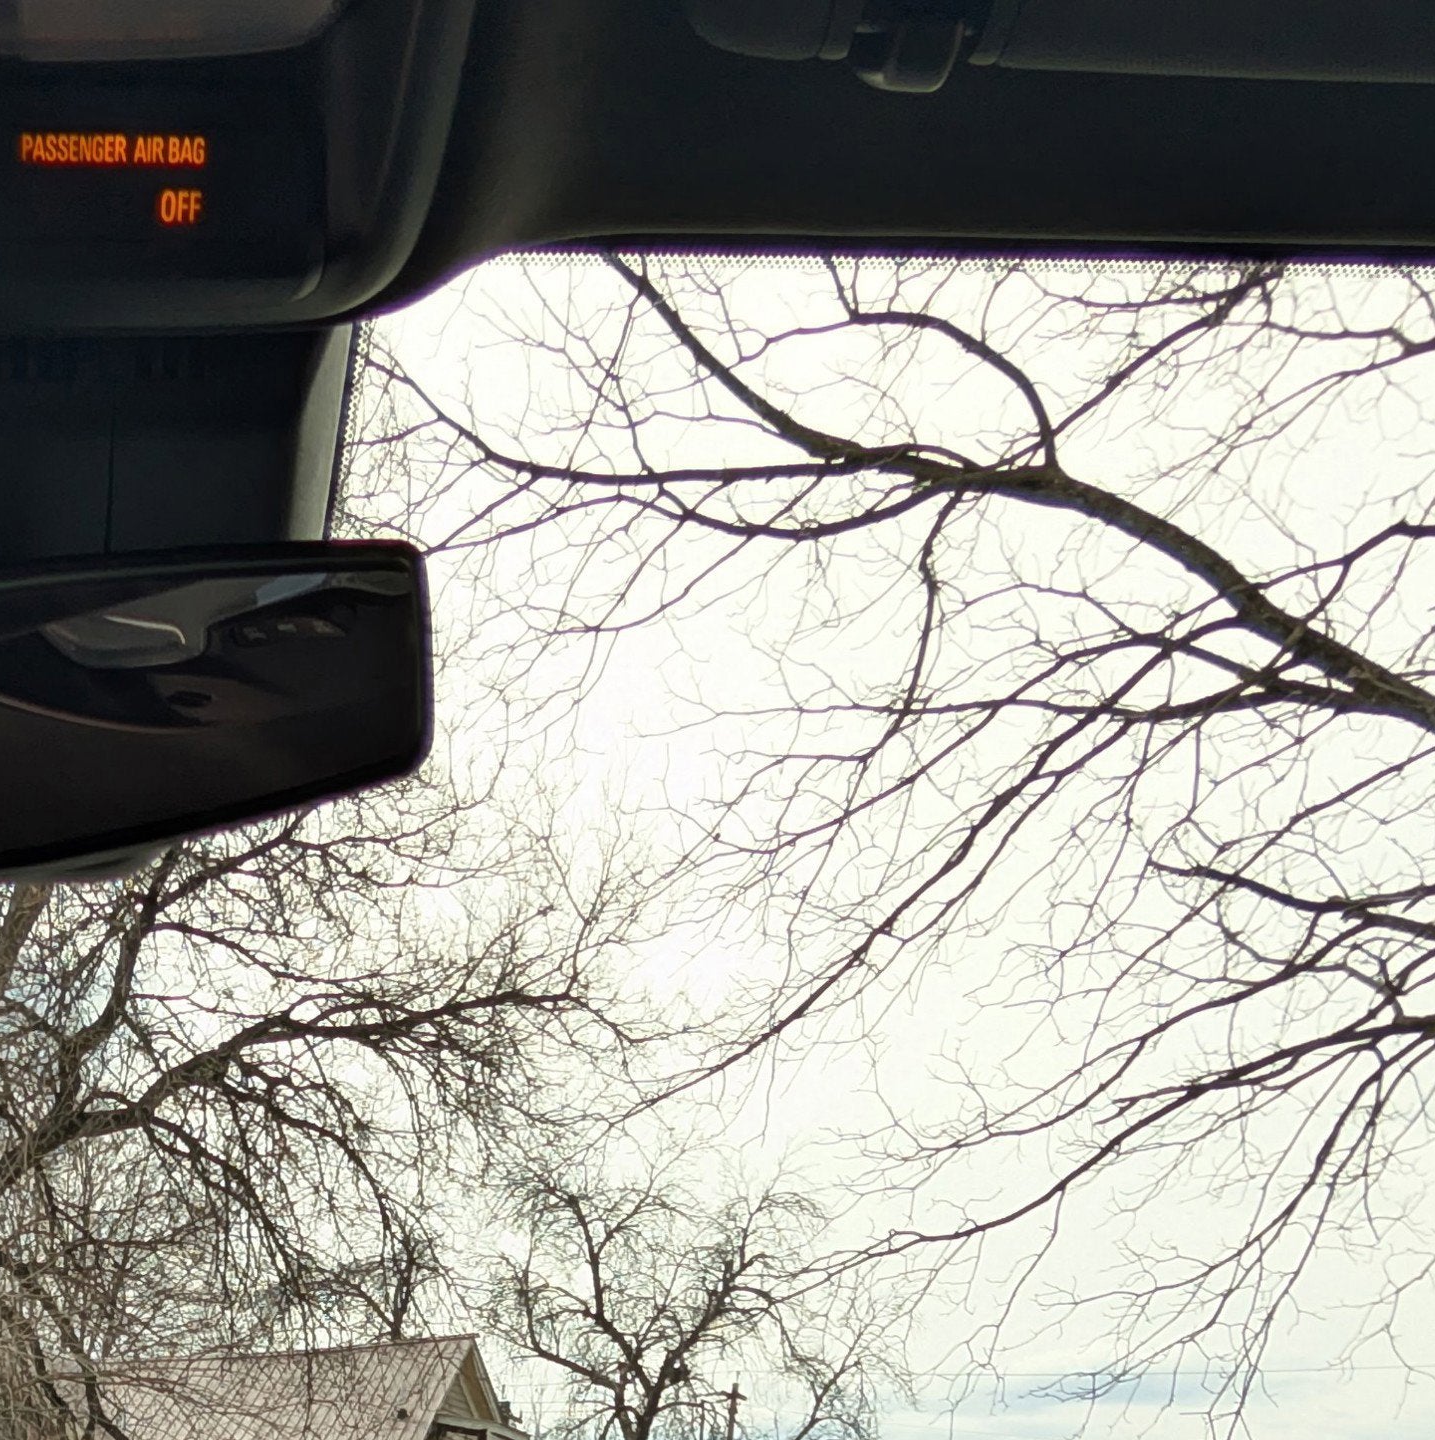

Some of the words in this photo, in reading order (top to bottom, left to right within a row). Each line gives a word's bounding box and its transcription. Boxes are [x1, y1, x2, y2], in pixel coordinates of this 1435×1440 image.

[21, 134, 127, 162] PASSENGER
[134, 136, 165, 163] AIR
[168, 136, 206, 164] BAG
[160, 190, 203, 223] OFF
